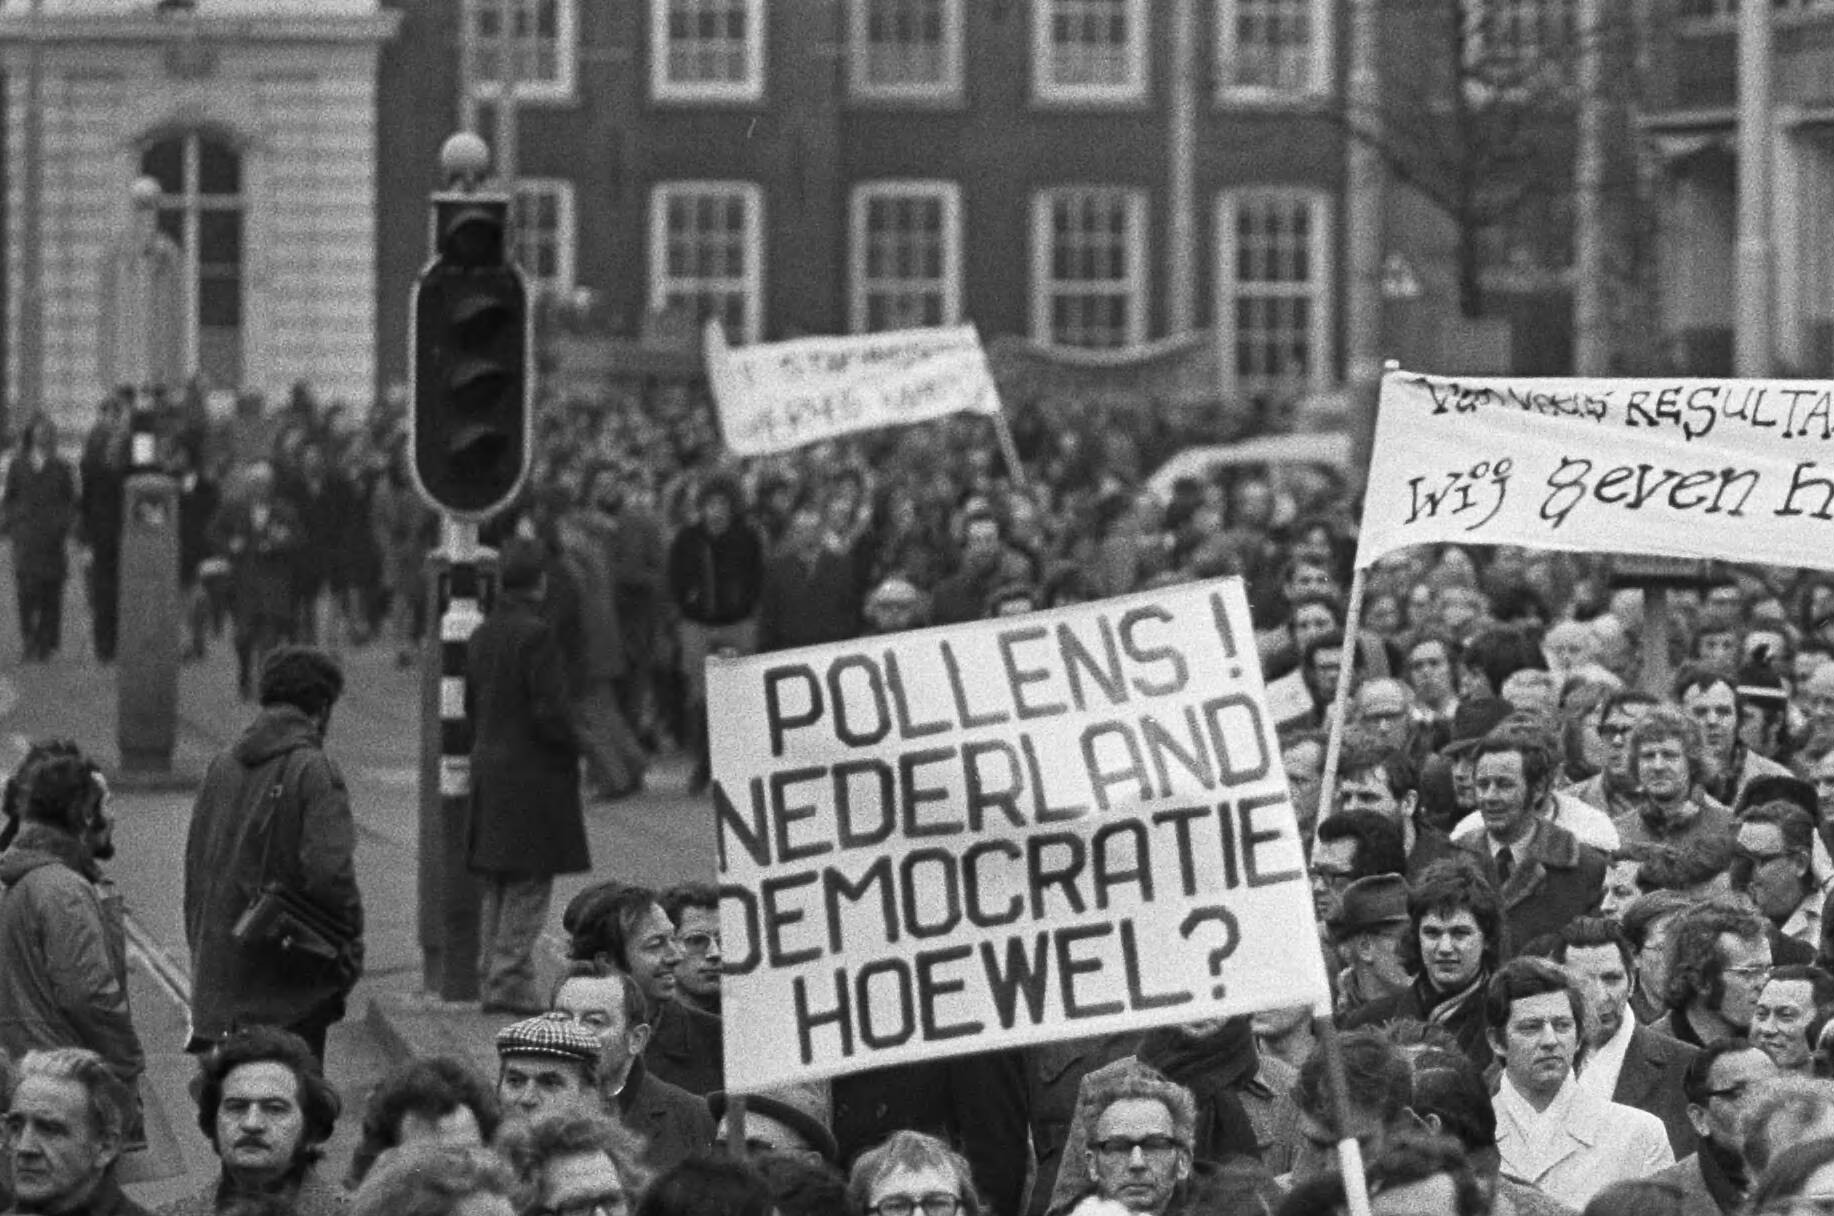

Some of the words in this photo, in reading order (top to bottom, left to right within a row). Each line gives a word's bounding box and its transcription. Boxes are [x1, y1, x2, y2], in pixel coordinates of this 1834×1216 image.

[1538, 455, 1762, 529] geven
[711, 690, 1273, 874] NEDERLAND
[716, 792, 1304, 976] DEMOCRATIE
[792, 903, 1243, 1066] HOEWEL?
